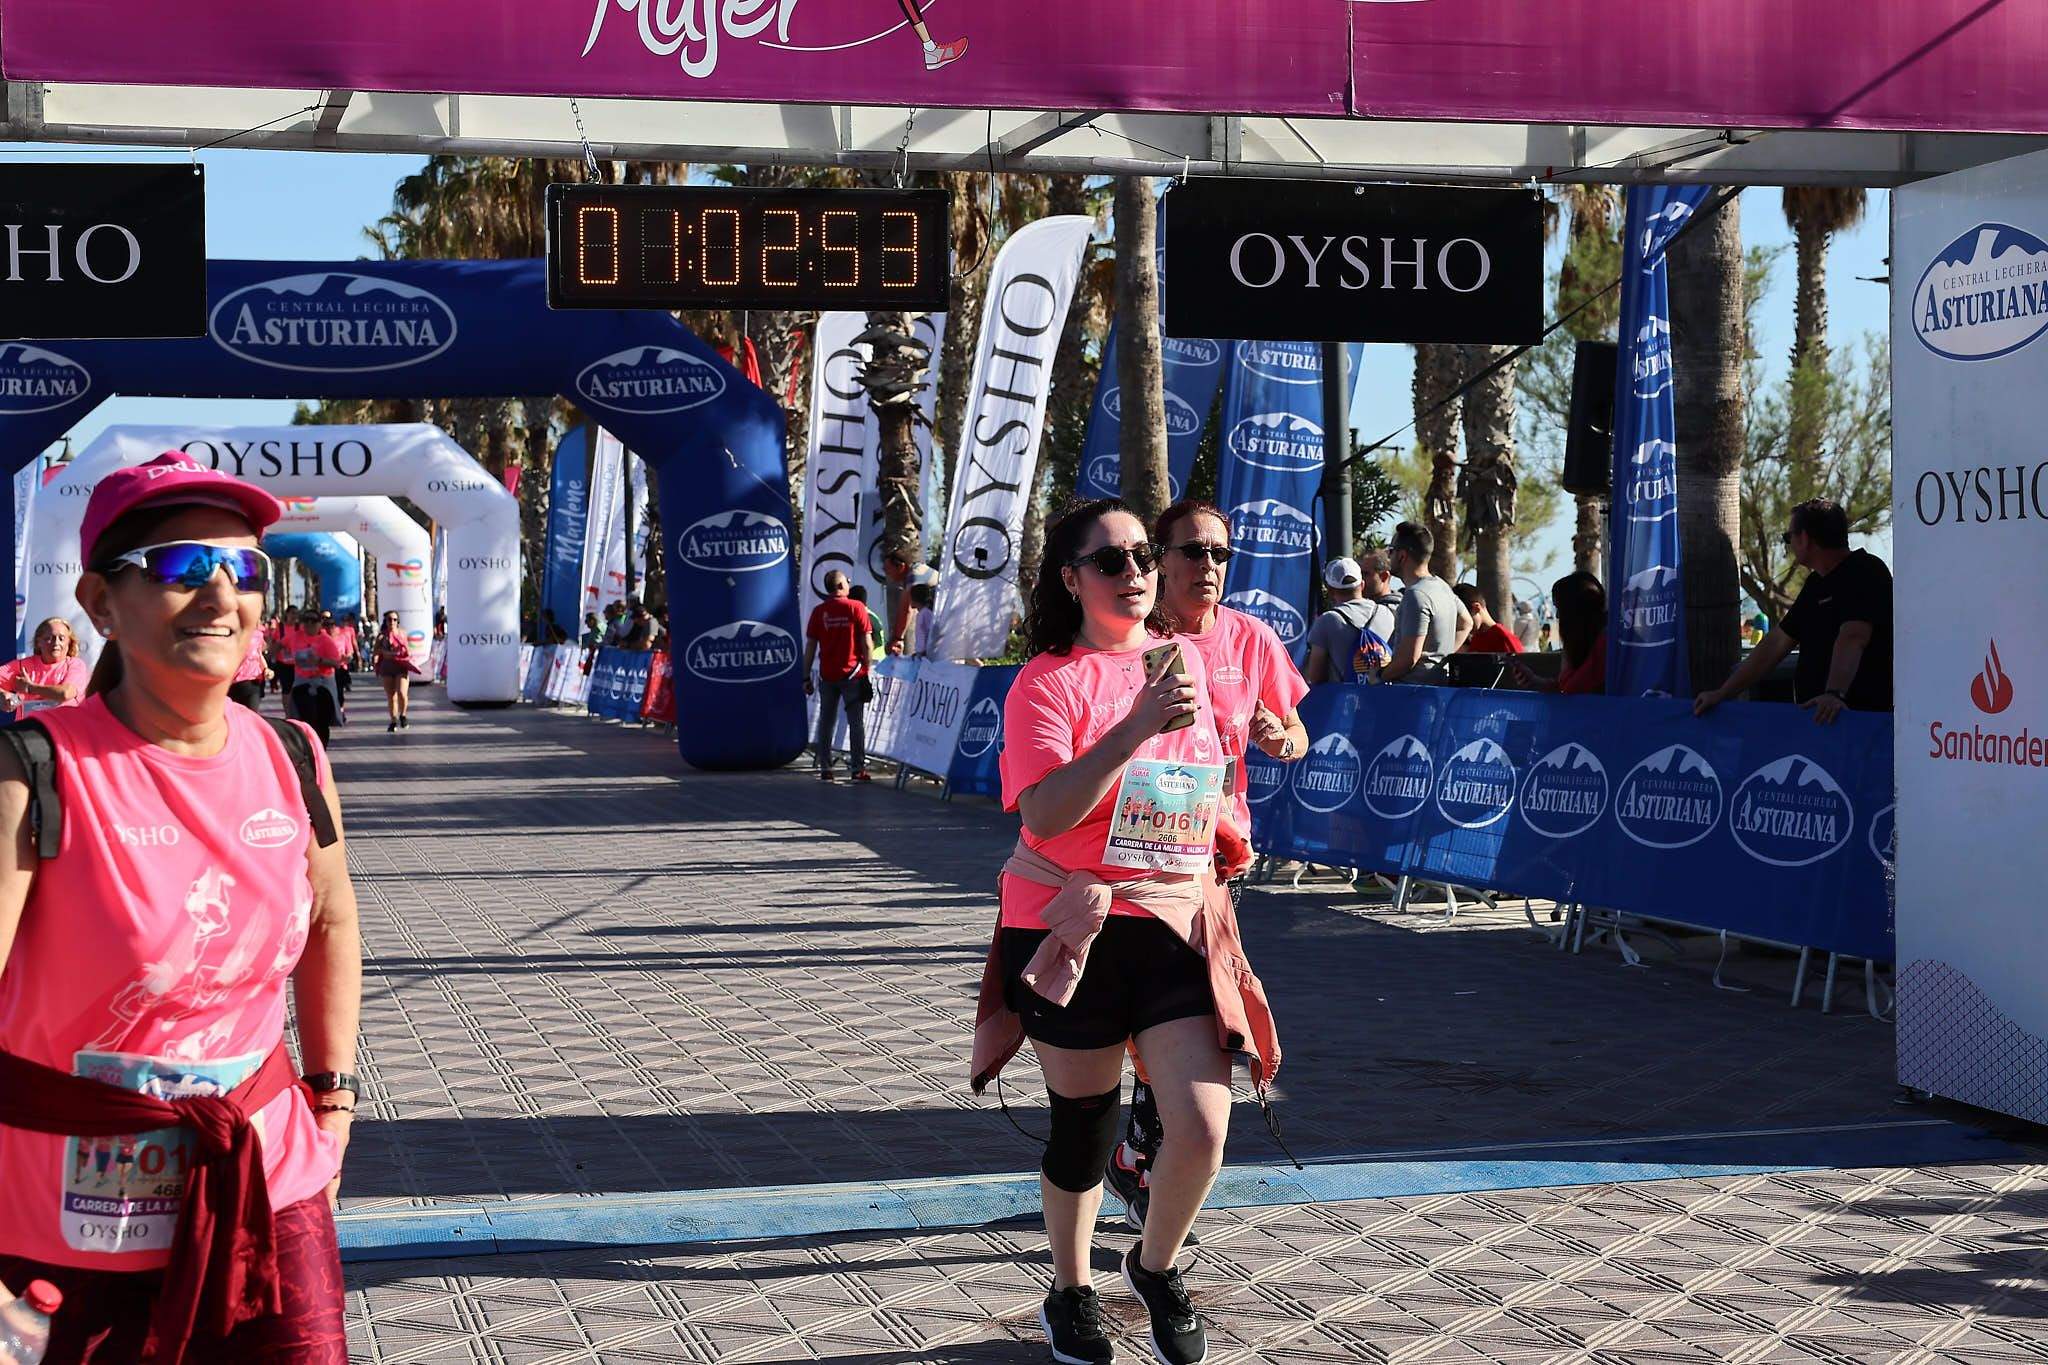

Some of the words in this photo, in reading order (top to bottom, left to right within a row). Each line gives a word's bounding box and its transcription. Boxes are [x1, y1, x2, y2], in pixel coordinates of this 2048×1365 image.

[580, 207, 918, 288] 01:02:53
[1230, 232, 1491, 292] OYSHO
[1944, 271, 1990, 290] CENTRAL
[1995, 261, 2047, 280] LECHERA
[267, 302, 345, 313] CENTRAL
[353, 302, 430, 313] LECHERA
[1922, 280, 2048, 333] ASTURIANA
[229, 302, 439, 346] ASTURIANA
[589, 373, 717, 398] ASTURIANA
[953, 273, 1056, 579] OYSHO
[60, 483, 97, 497] OYS
[687, 535, 786, 558] ASTURIANA
[459, 557, 512, 569] OYSHO
[459, 633, 512, 645] OYSHO
[694, 645, 793, 668] ASTURIANA
[1296, 760, 1354, 792] ASTURIANA
[1368, 765, 1427, 798] ASTURIANA
[1440, 769, 1508, 807] ASTURIANA
[1524, 775, 1600, 815] ASTURIANA
[1621, 781, 1712, 825] ASTURIANA
[1152, 811, 1190, 830] 016
[1736, 790, 1837, 843] ASTURIANA
[1115, 838, 1143, 849] CARRERA
[1158, 834, 1177, 842] 2606
[1118, 852, 1153, 862] OYSHO
[72, 1197, 127, 1214] CARRERA
[130, 1201, 144, 1213] DE
[146, 1201, 161, 1211] LA
[79, 1222, 148, 1239] OYSHO
